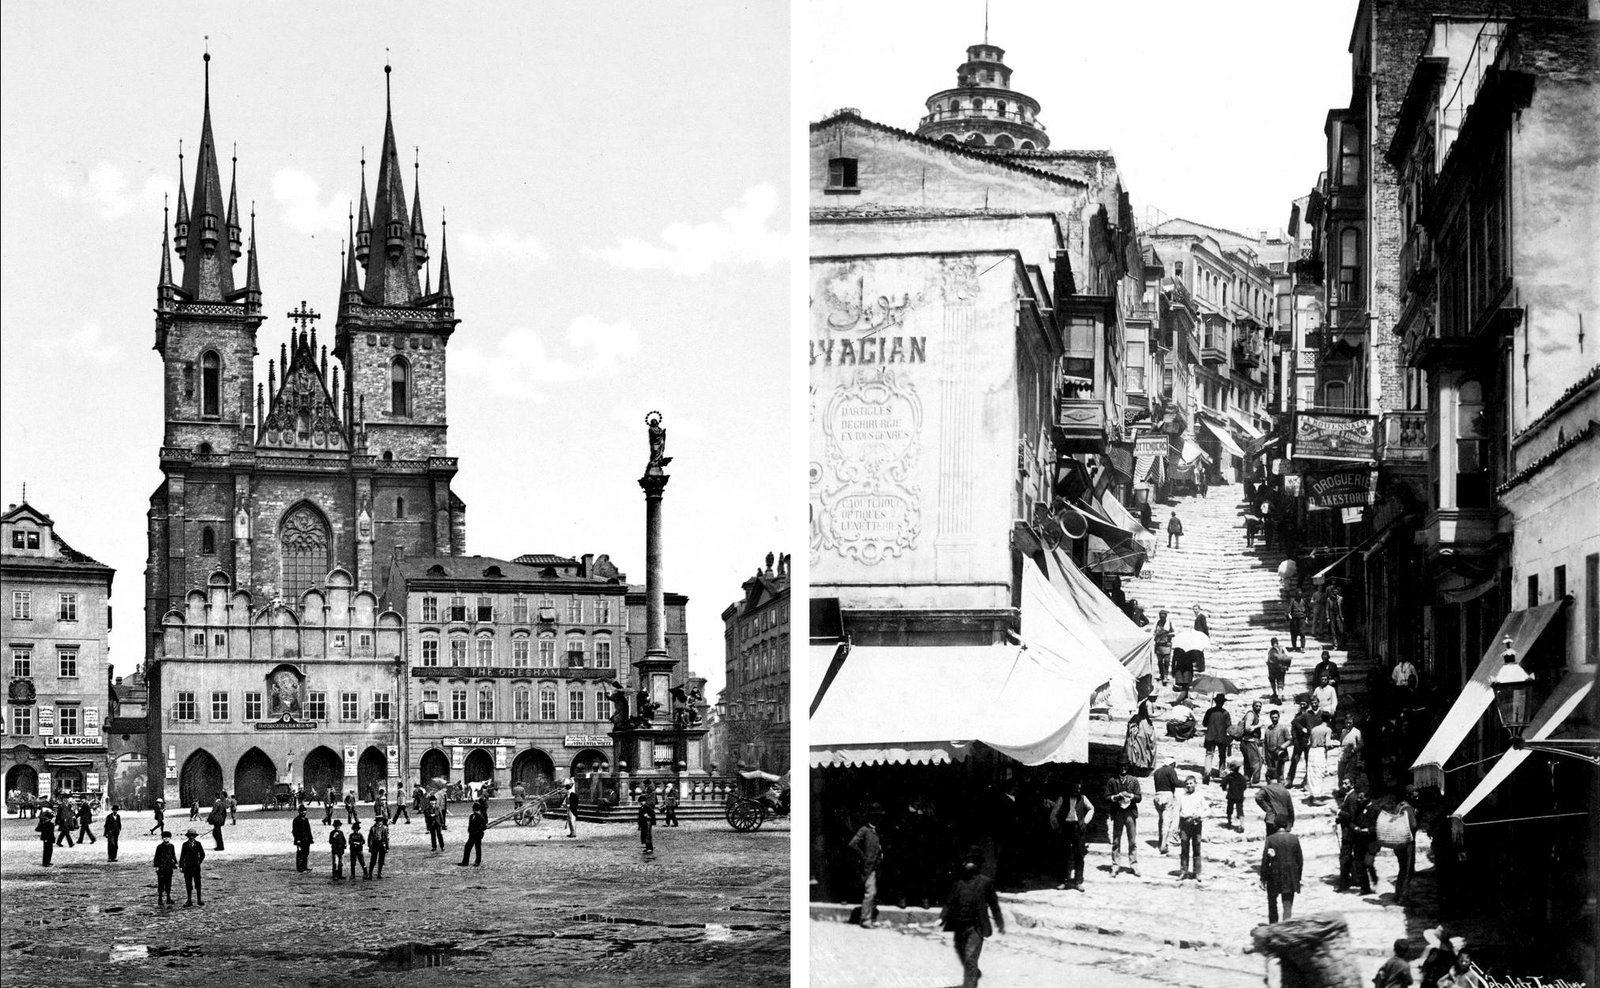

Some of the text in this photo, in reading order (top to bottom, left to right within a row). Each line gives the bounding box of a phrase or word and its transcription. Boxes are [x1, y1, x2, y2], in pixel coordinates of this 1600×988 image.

[471, 668, 562, 677] THE GRESHAM
[63, 737, 100, 745] ALTSCHUL
